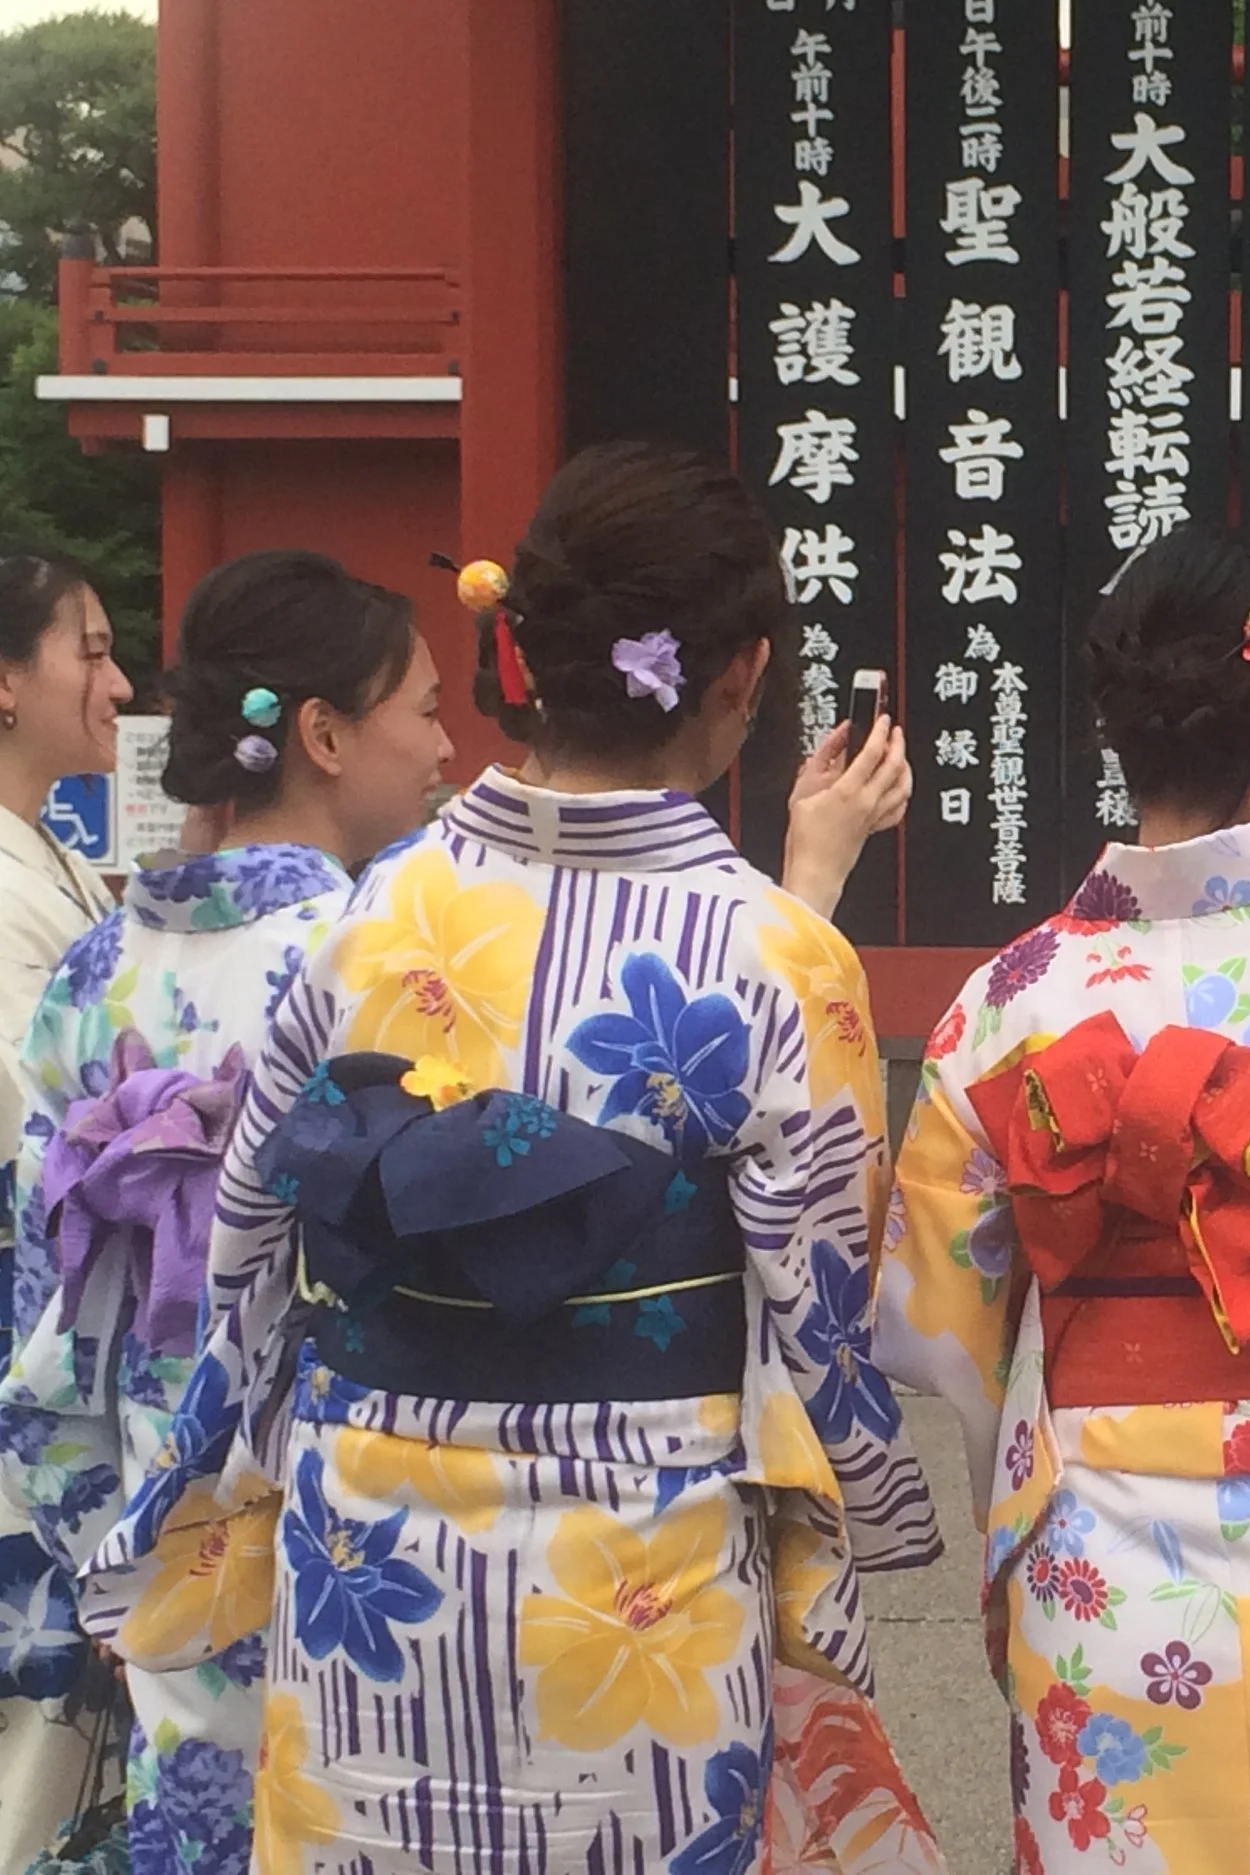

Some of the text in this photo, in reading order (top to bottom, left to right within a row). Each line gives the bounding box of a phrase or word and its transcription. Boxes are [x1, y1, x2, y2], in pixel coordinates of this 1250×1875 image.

[791, 30, 833, 175] 午前十時
[1129, 0, 1173, 105] 前十時
[769, 181, 860, 604] 大護摩供
[938, 178, 1023, 604] 聖観音法
[1099, 113, 1195, 595] 大般若経転読
[934, 662, 979, 825] 御縁日
[988, 662, 1028, 904] 本尊聖観世音菩薩
